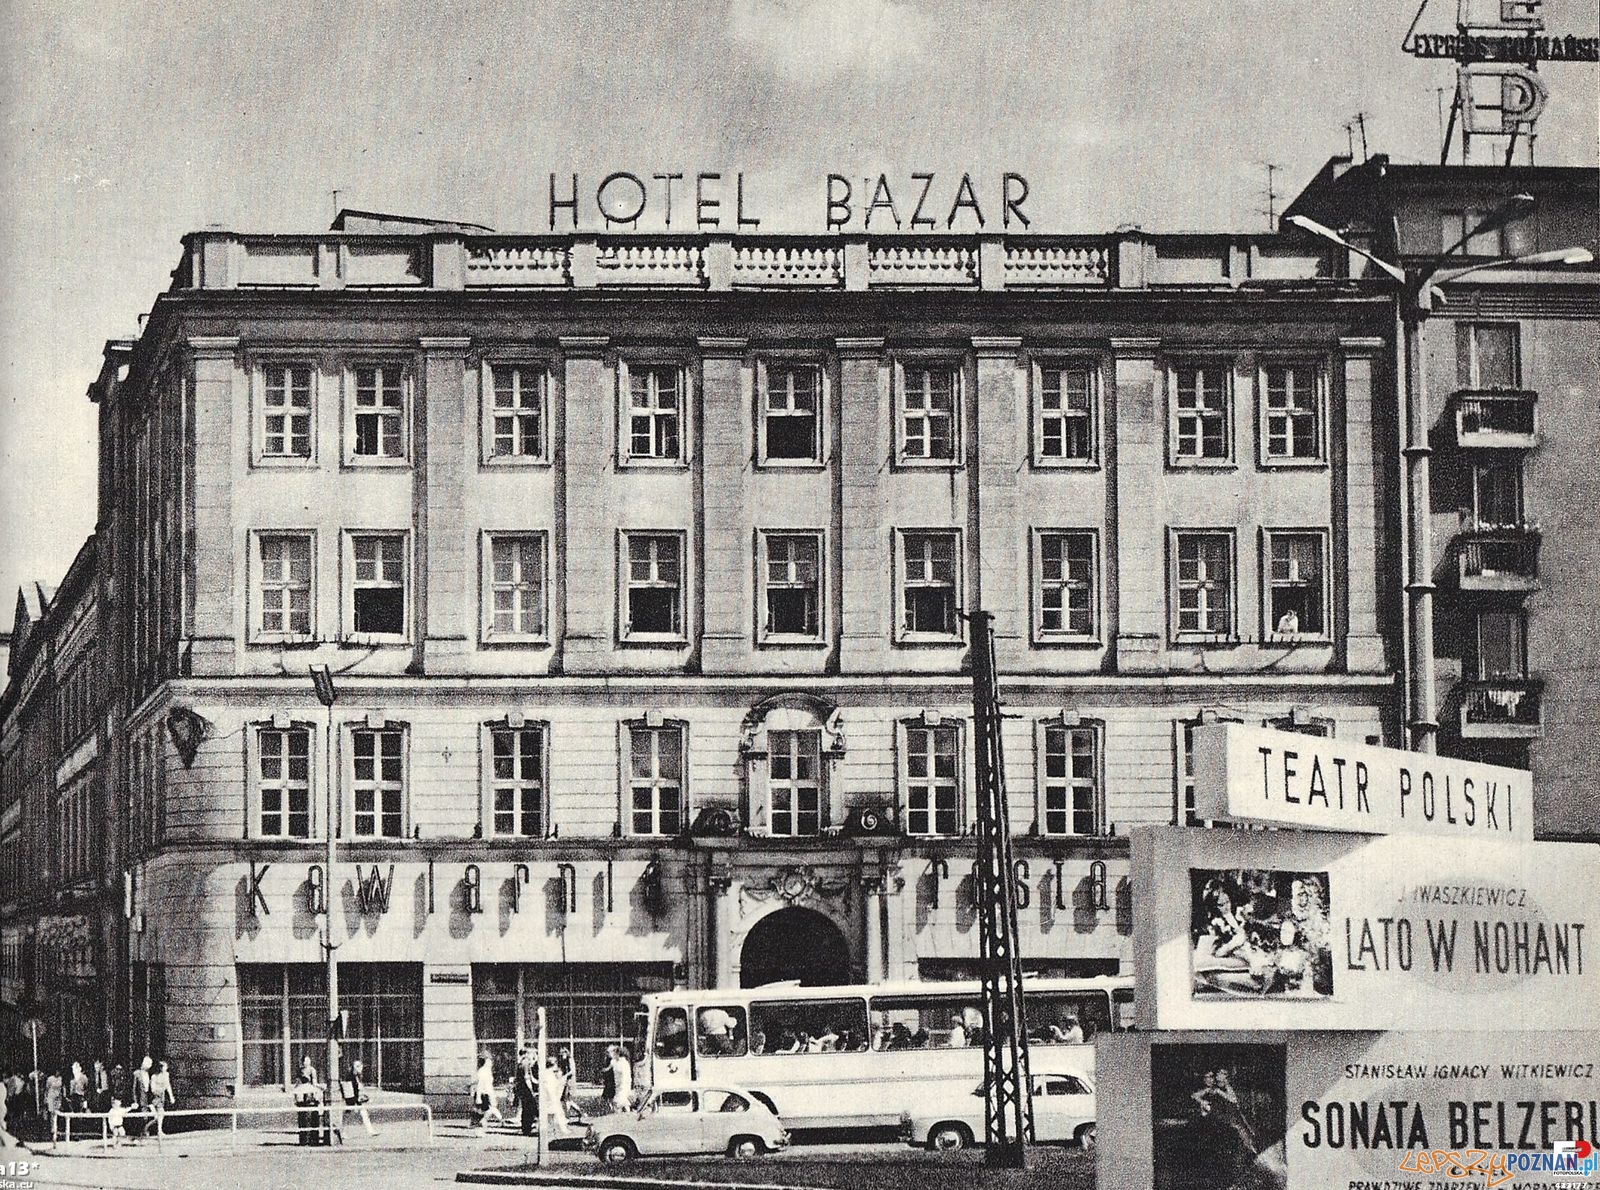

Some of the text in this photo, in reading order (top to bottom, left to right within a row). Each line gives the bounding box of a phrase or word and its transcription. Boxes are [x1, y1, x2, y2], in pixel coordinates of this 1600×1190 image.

[549, 172, 1031, 230] HOTEL BAZAR
[1258, 747, 1513, 832] TEATR POLSKI
[1412, 885, 1527, 908] IWASZKIEWICZ
[1345, 917, 1586, 976] LATO W NOHANT
[1345, 1063, 1594, 1080] STANISŁAW IGNACY WITKIEWICZ
[1302, 1100, 1430, 1149] SONATA
